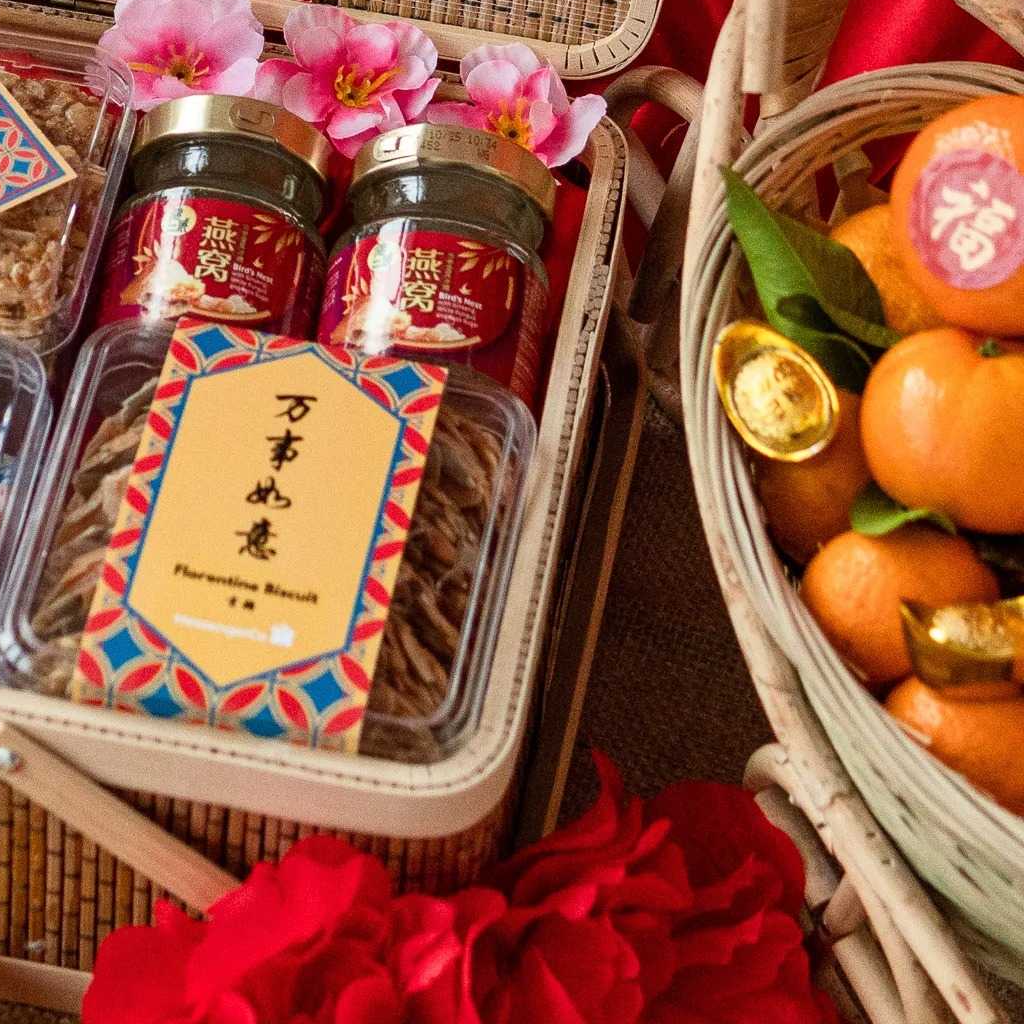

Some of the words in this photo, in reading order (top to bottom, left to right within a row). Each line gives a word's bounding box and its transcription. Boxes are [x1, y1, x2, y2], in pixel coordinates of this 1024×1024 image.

[930, 179, 1018, 273] 福
[235, 394, 318, 560] 万事如意
[263, 582, 318, 605] Biscuit
